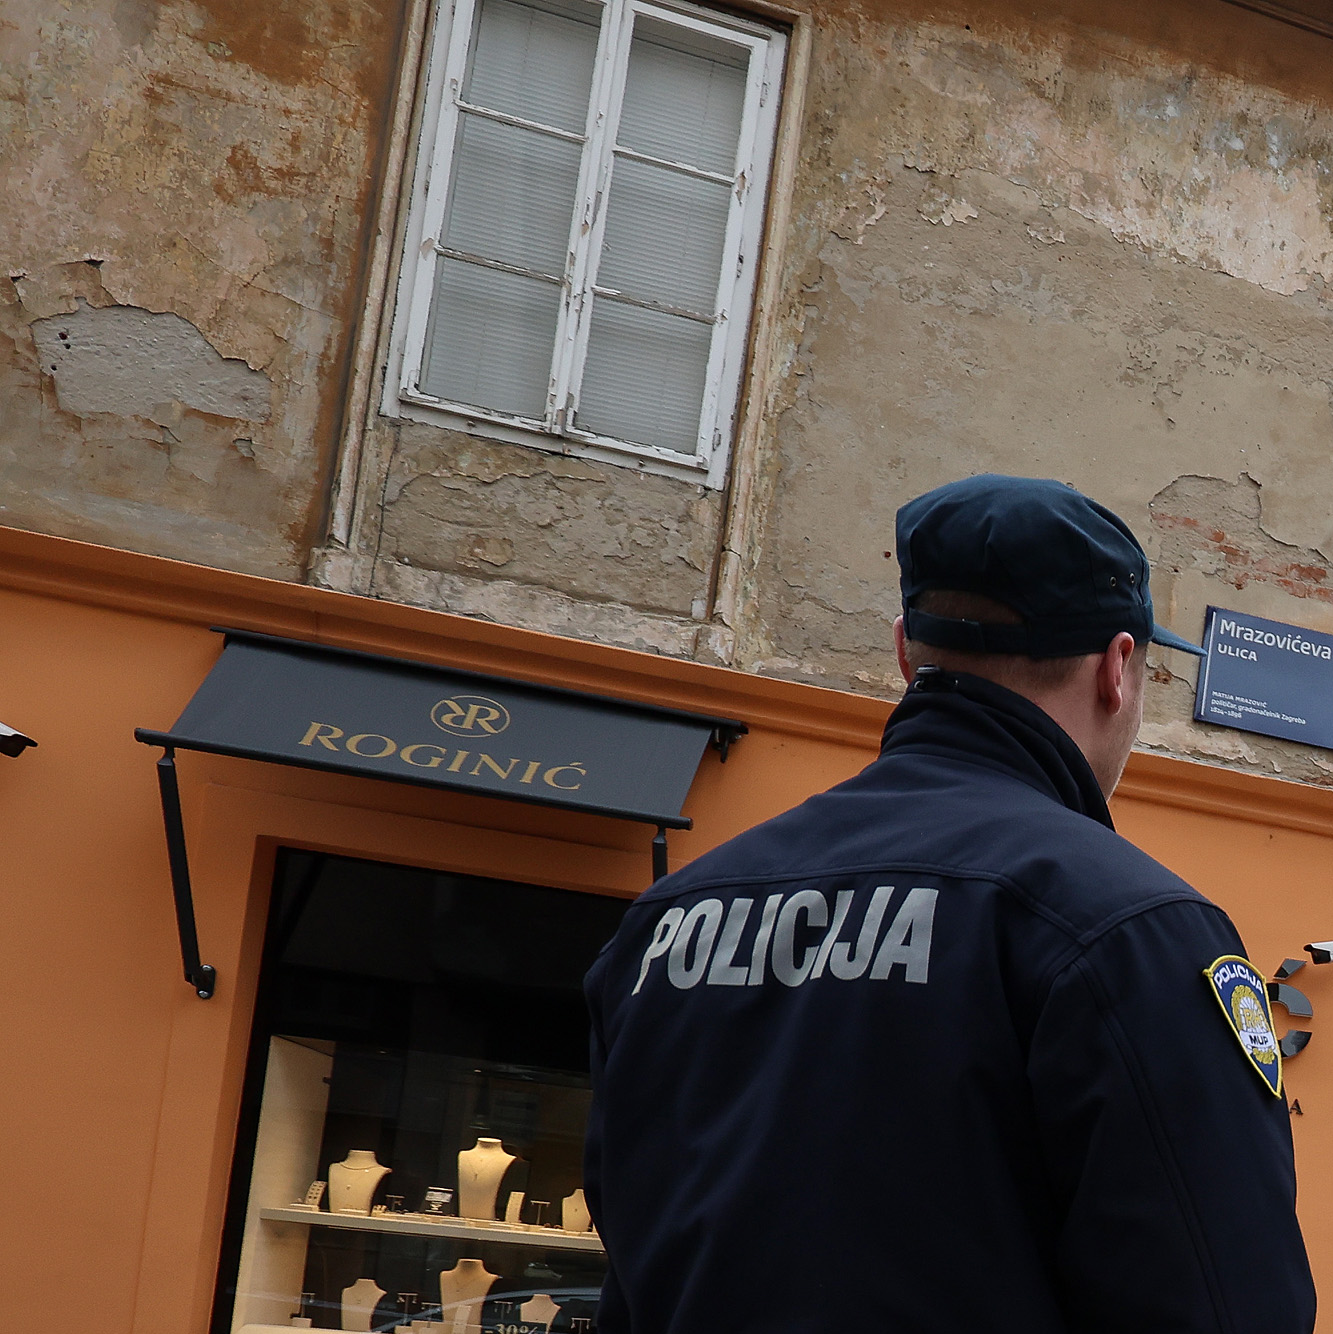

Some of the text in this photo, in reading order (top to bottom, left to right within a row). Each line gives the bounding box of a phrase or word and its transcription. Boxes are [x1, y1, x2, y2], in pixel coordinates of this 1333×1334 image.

[1219, 619, 1332, 660] Mrazovićeva
[1217, 643, 1258, 662] ULICA
[1235, 695, 1268, 708] MRAZOVIĆ
[1281, 713, 1307, 725] Zagreba
[297, 720, 588, 791] ROGINIĆ
[631, 885, 940, 997] POLICIJA
[1213, 964, 1265, 995] POLICIJA
[1248, 1034, 1269, 1046] MUP
